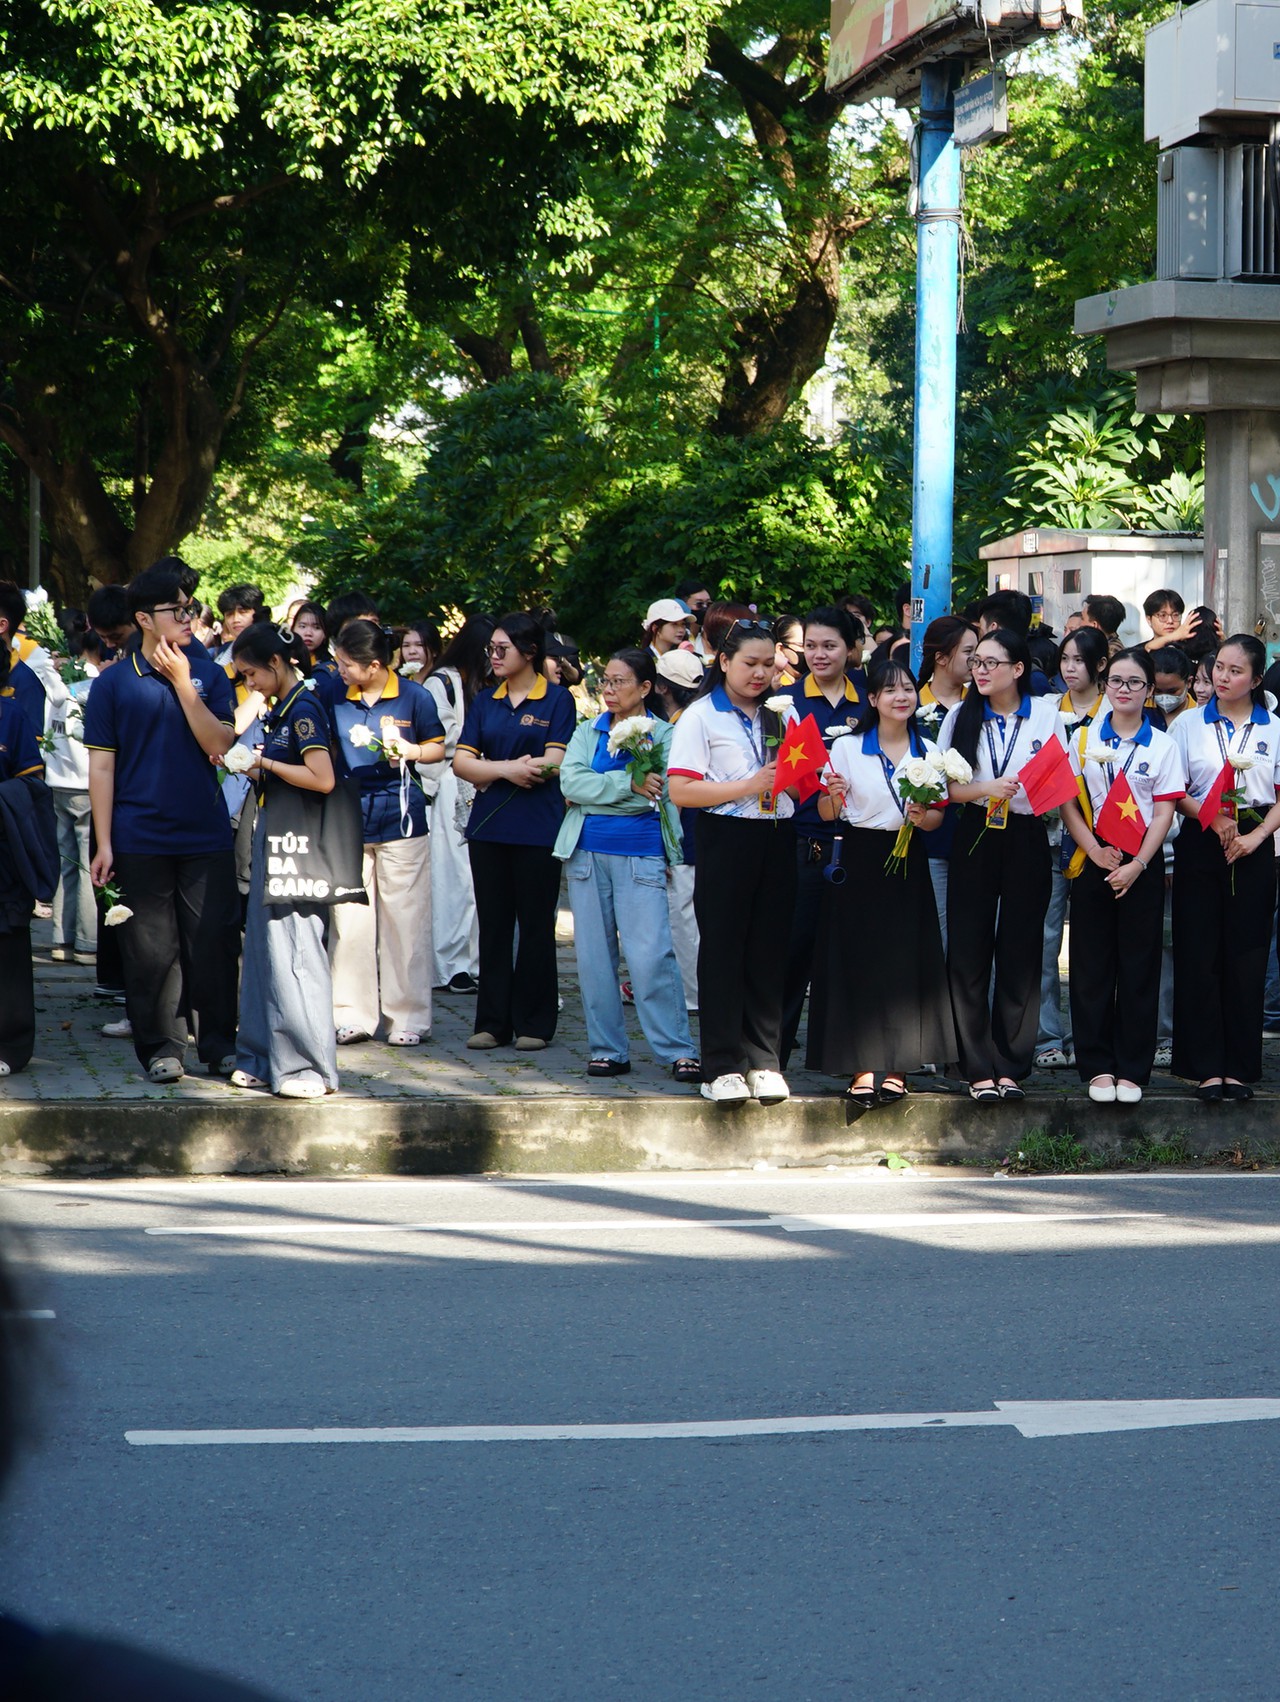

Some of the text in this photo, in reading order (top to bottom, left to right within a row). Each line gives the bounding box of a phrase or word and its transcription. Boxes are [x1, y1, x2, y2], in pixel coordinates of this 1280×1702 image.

[268, 831, 309, 854] TÚI
[268, 857, 299, 875] BA
[268, 878, 330, 898] GANG
